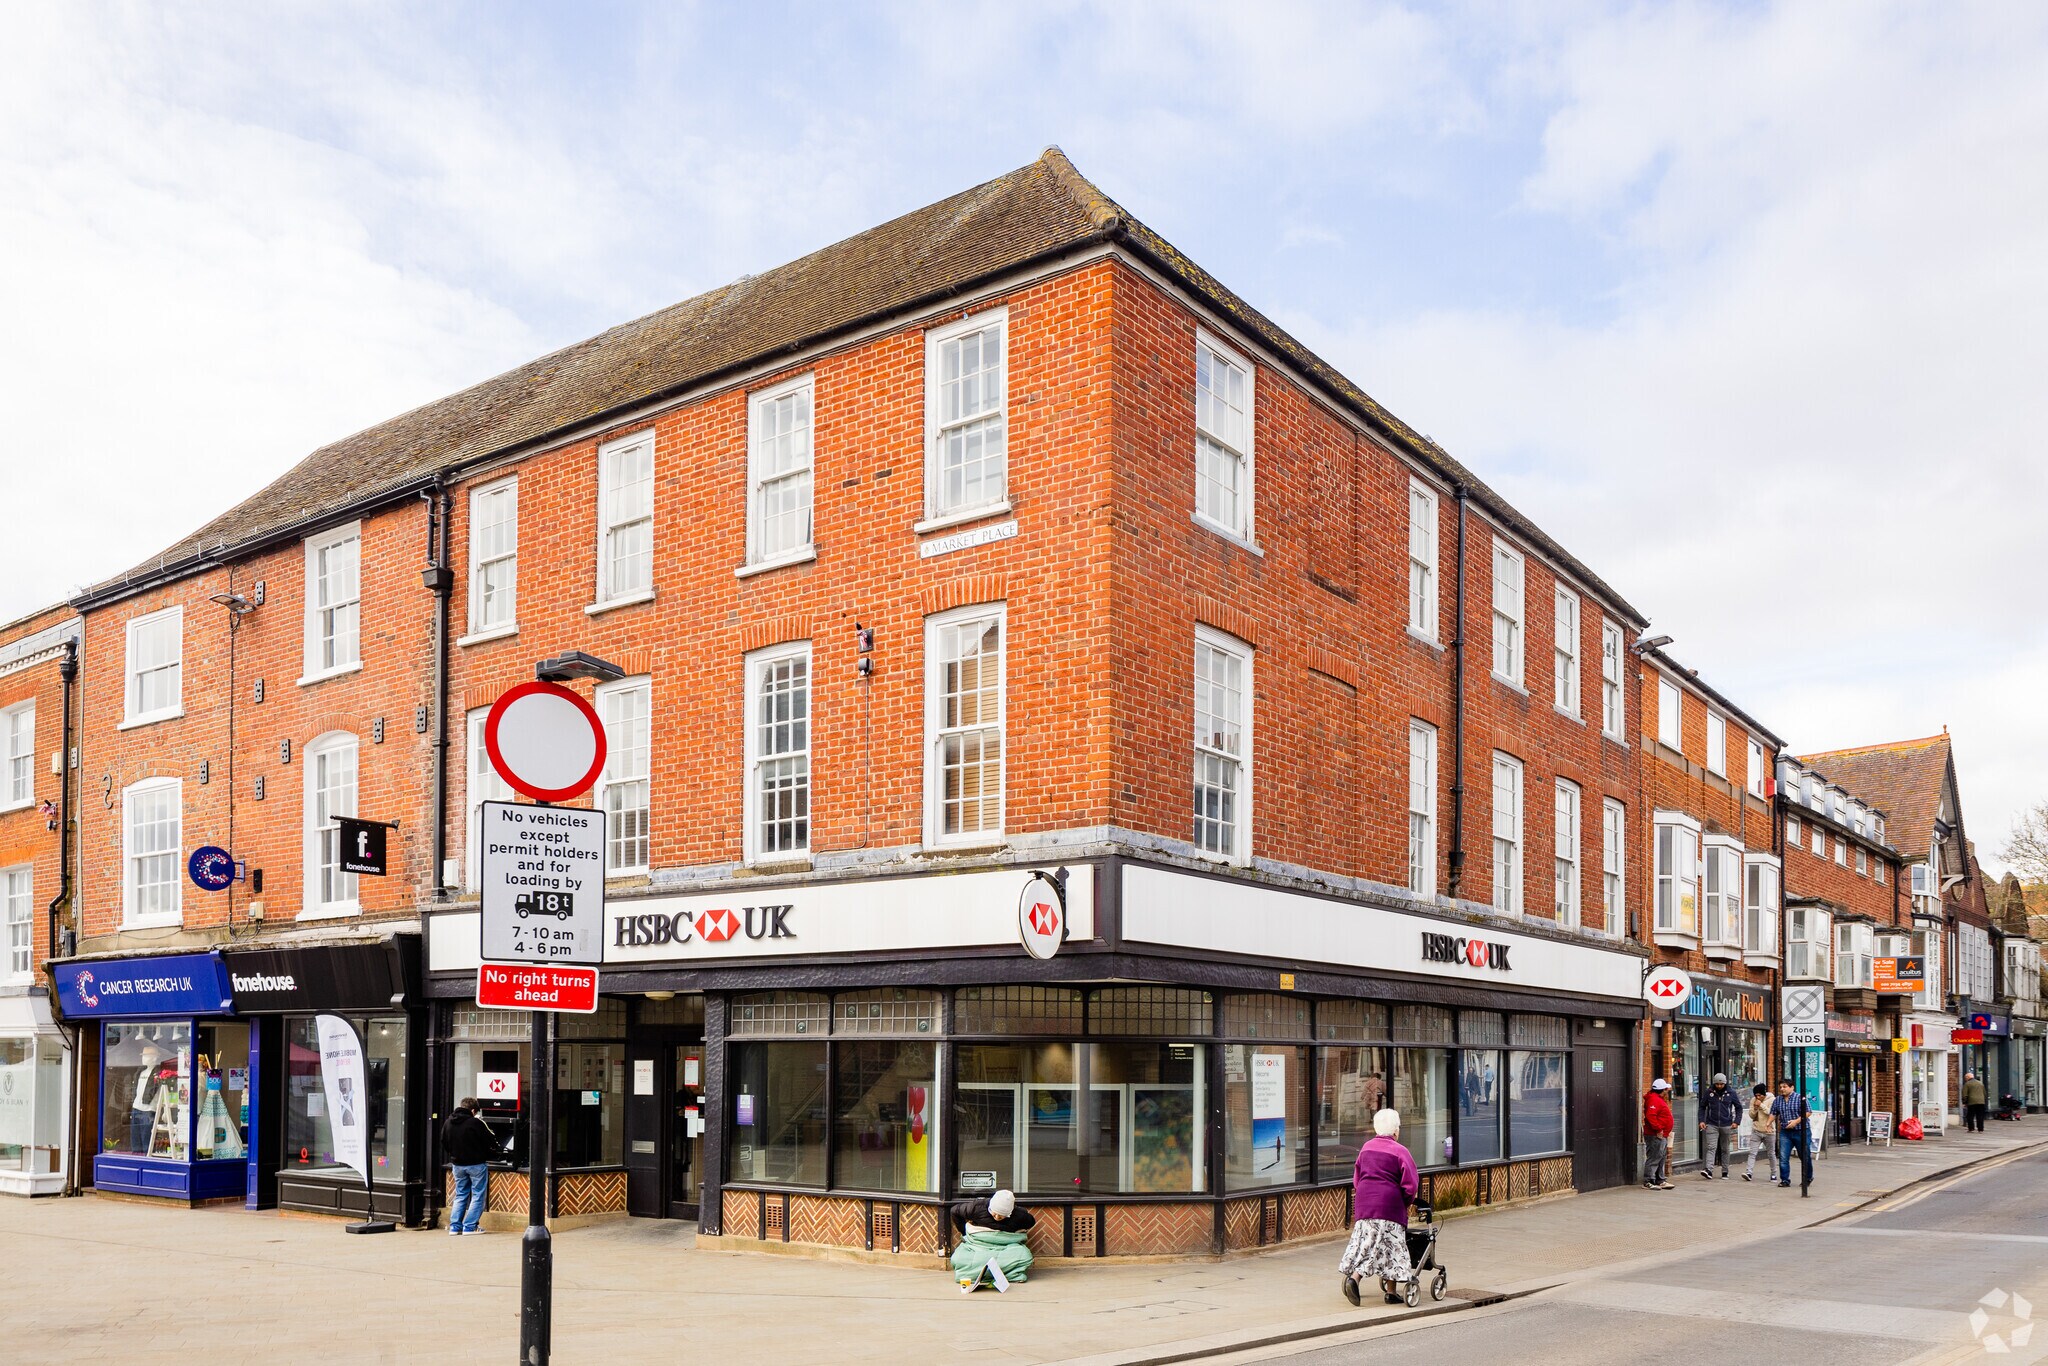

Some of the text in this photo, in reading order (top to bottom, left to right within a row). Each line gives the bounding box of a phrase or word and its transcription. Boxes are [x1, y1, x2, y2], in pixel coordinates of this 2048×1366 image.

[933, 524, 1015, 554] MARKET PLACE
[502, 809, 588, 828] No vehicles
[520, 830, 570, 844] except
[489, 844, 599, 860] permit holders
[346, 862, 380, 873] fonehouse
[518, 860, 571, 873] and for
[506, 872, 582, 890] loading by
[614, 905, 797, 947] HSBC UK
[553, 931, 574, 940] am
[550, 946, 572, 956] pm
[1421, 932, 1513, 970] HSBC UK
[100, 976, 193, 995] CANCER RESEARCH UK
[485, 969, 591, 988] No right turns
[514, 988, 559, 1002] ahead
[1714, 988, 1740, 1020] Good
[1742, 993, 1764, 1021] Food
[1787, 1035, 1821, 1043] ENDS
